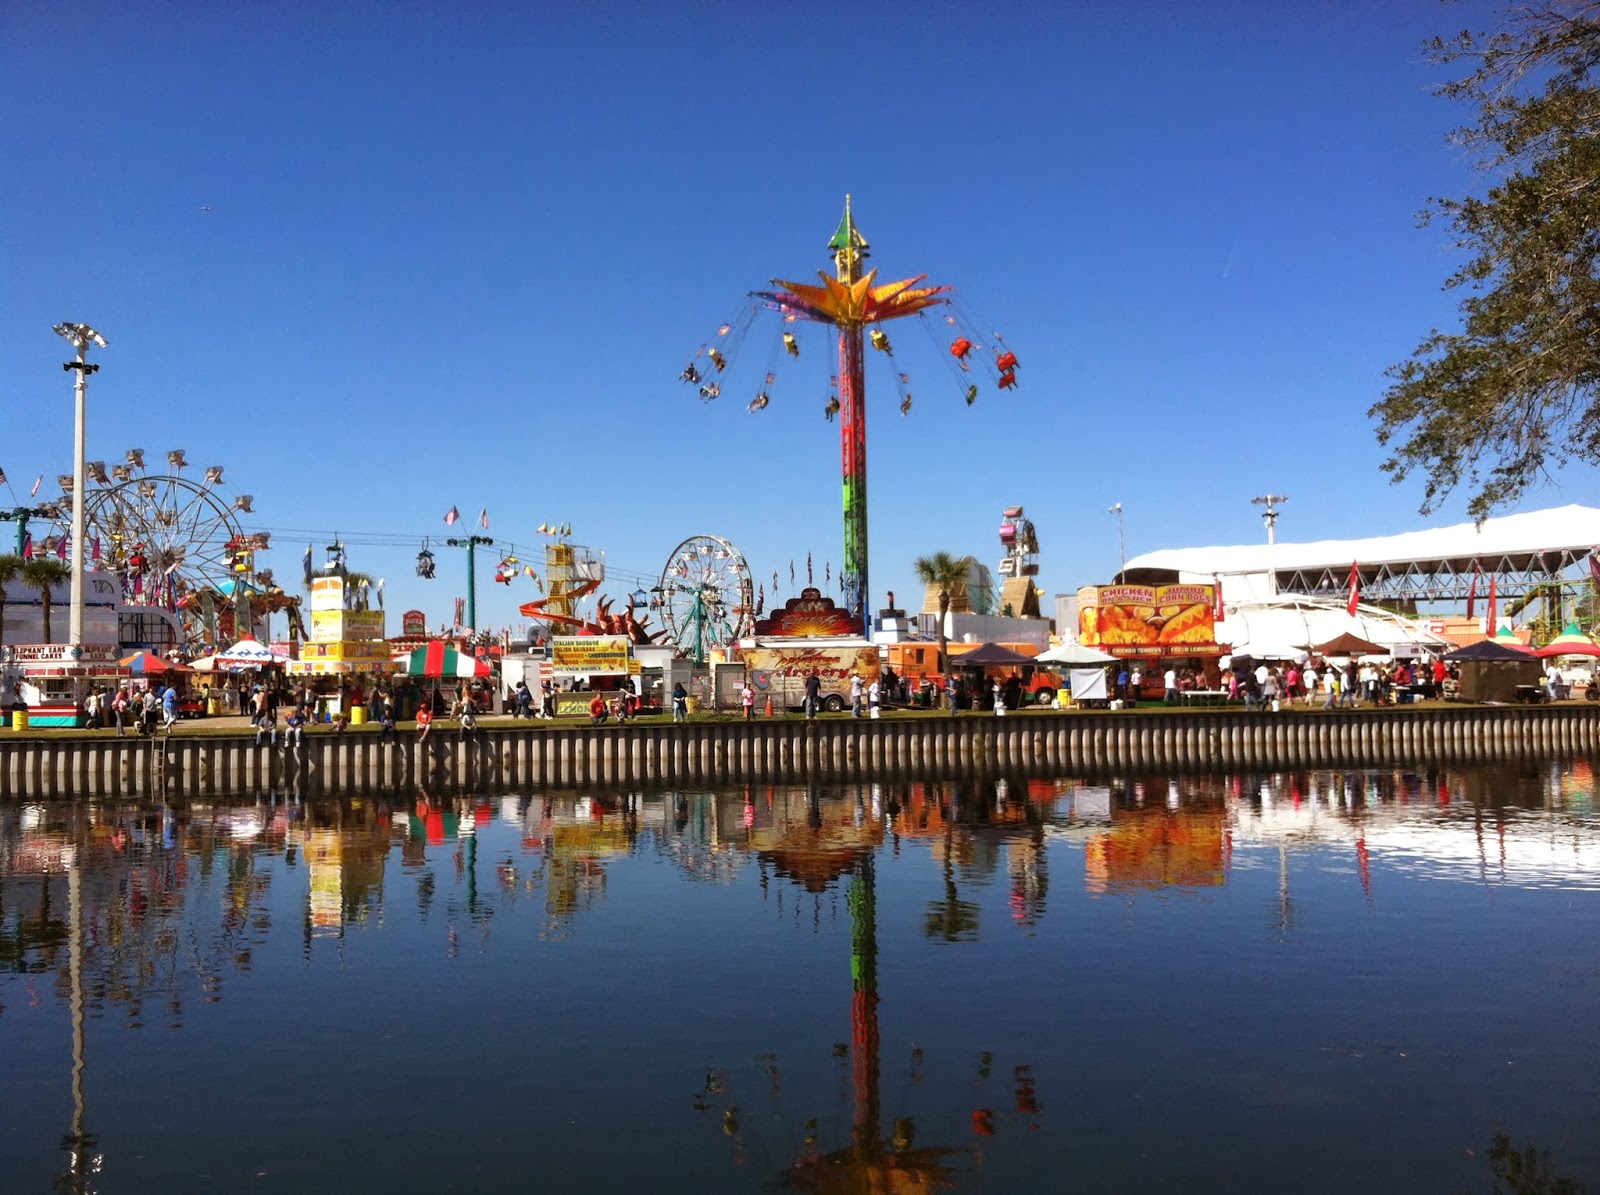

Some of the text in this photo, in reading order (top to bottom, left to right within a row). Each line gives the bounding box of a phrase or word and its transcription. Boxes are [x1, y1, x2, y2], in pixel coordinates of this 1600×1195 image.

[1101, 588, 1153, 598] CHICKEN
[1160, 594, 1211, 603] CORN DOGS
[776, 667, 849, 678] Archery
